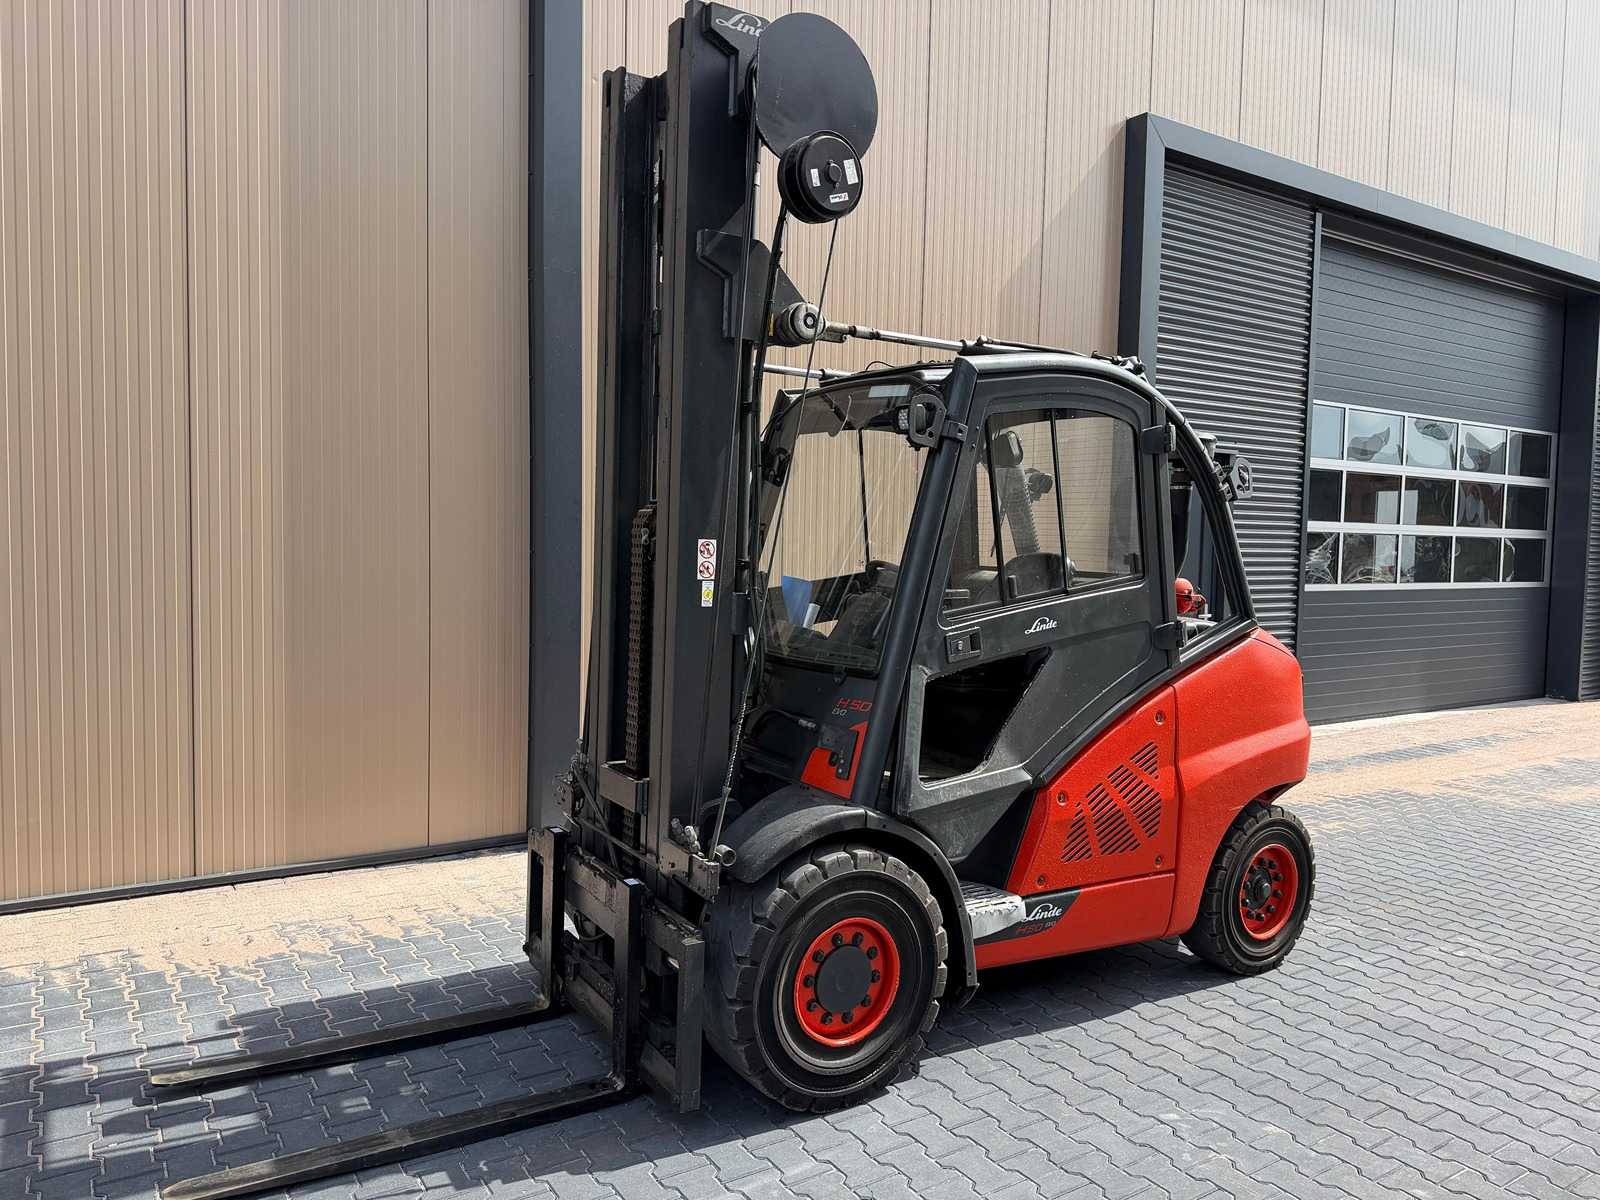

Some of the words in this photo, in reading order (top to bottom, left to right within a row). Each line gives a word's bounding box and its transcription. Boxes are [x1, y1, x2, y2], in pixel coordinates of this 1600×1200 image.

[715, 13, 763, 37] Lin
[1024, 616, 1057, 634] Linde
[837, 697, 873, 712] H50
[1020, 903, 1063, 922] Linde
